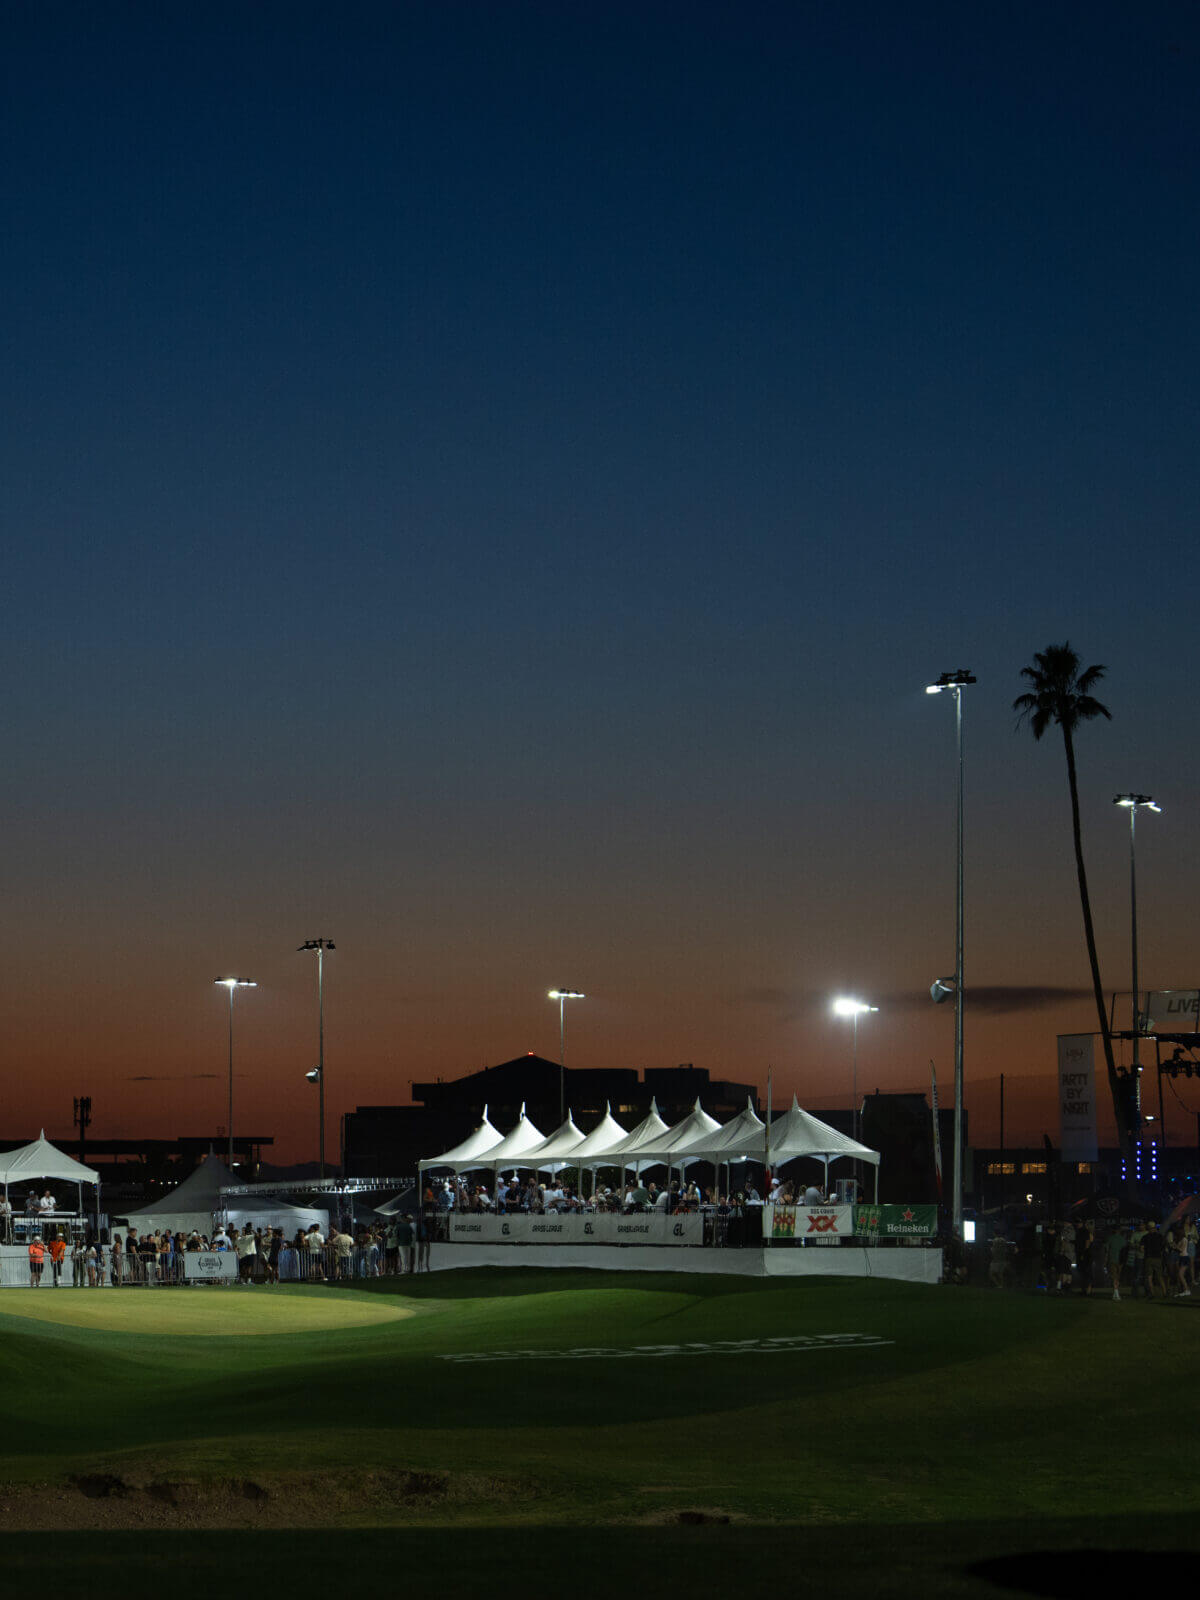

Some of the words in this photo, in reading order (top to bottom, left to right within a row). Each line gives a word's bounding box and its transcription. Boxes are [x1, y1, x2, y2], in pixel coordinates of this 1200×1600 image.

[1062, 1072, 1089, 1086] PARTY
[1066, 1087, 1083, 1099] BY
[1063, 1102, 1089, 1114] NIGHT
[807, 1215, 839, 1233] XX
[887, 1223, 929, 1233] Heineken
